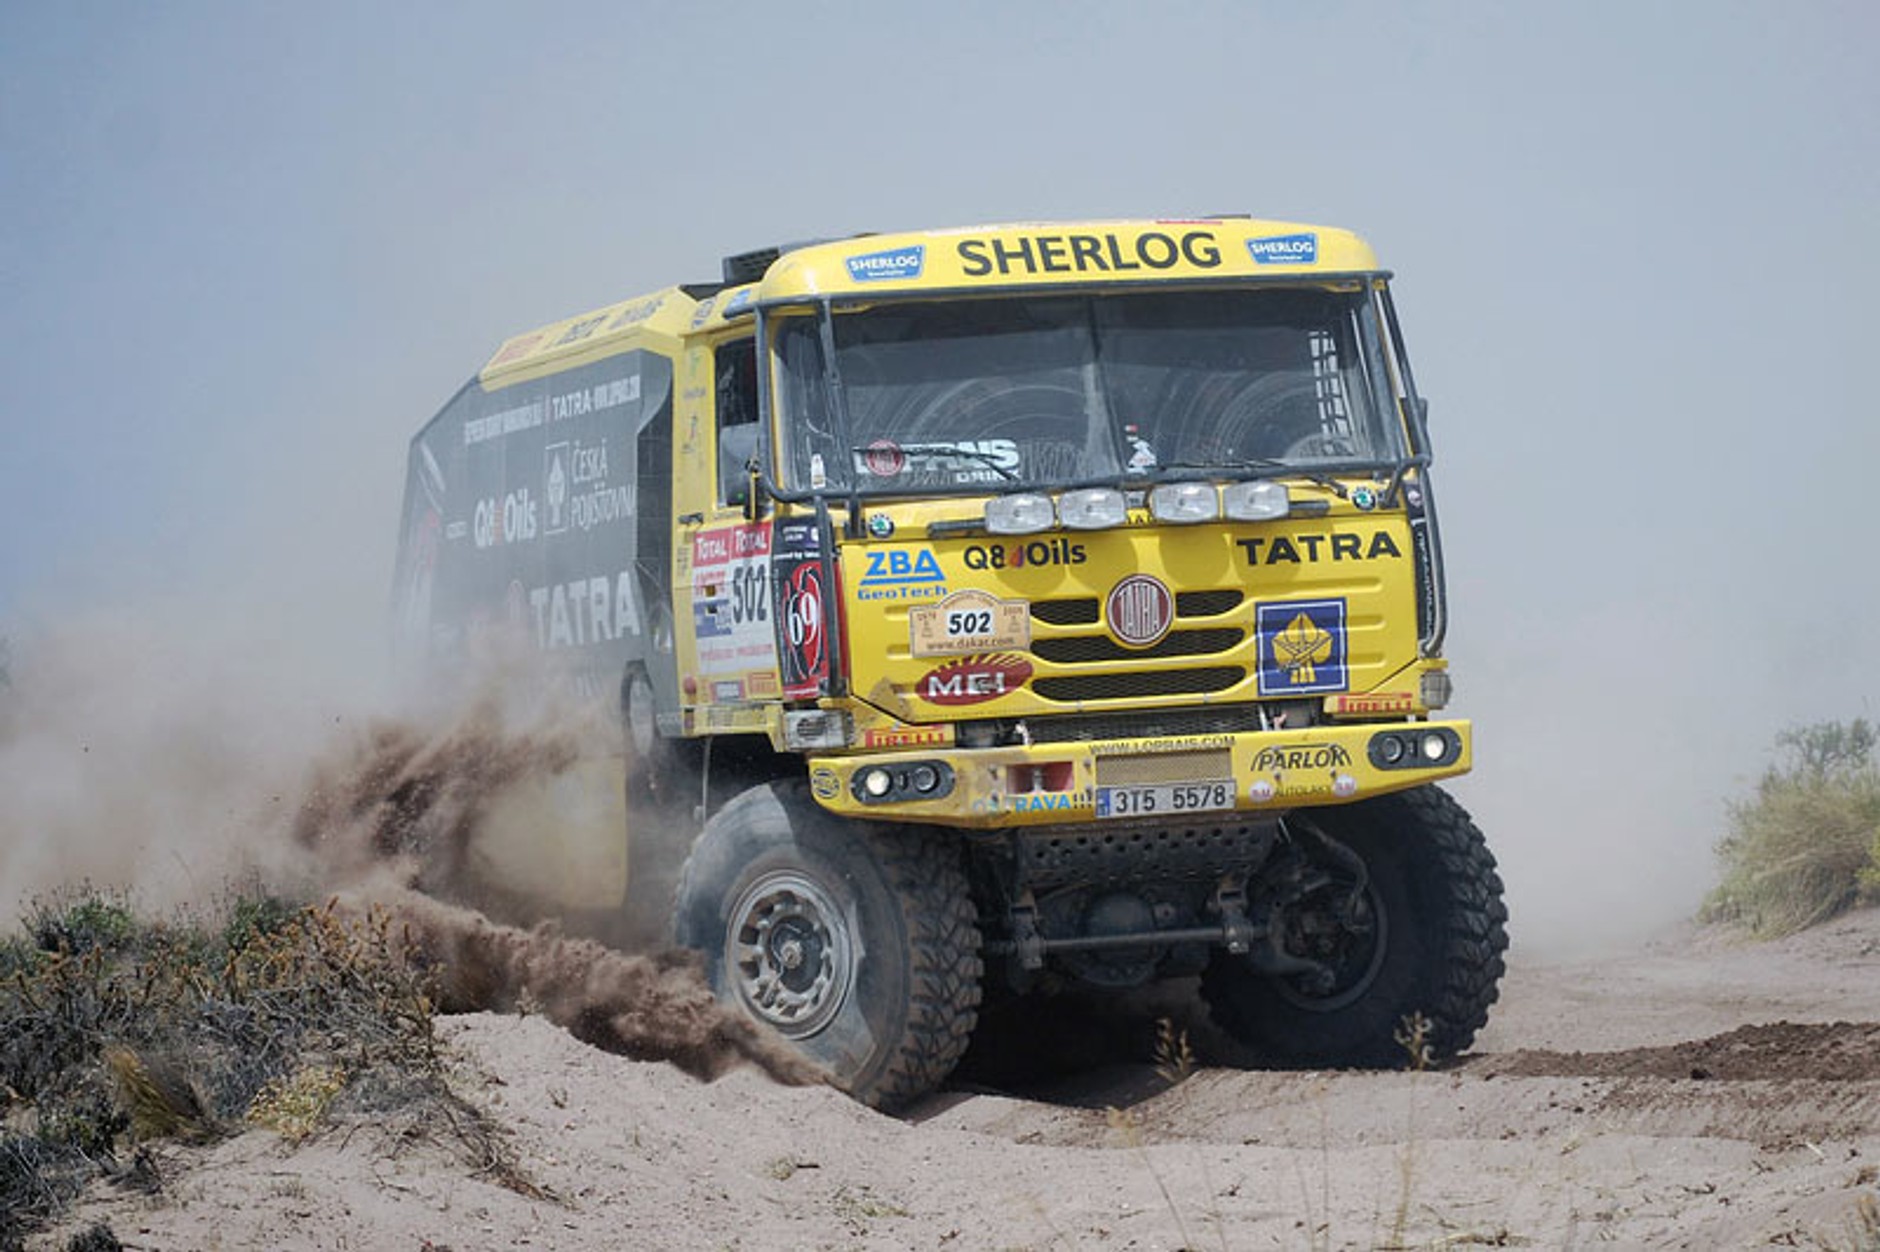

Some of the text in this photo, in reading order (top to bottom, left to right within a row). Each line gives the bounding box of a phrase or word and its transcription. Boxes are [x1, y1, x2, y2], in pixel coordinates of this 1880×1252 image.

[957, 232, 1220, 276] SHERLOG
[1250, 241, 1313, 254] SHERLOG
[850, 255, 919, 272] SHERLOG
[552, 388, 592, 420] TATRA
[504, 487, 537, 543] Oils
[696, 537, 727, 560] TOTAL
[735, 528, 768, 552] TOTAL
[963, 538, 1087, 570] Q8 Oils
[1236, 531, 1401, 566] TATRA
[864, 549, 945, 580] ZBA
[733, 564, 767, 624] 502
[857, 585, 948, 601] GeoTech
[530, 569, 641, 649] TATRA
[948, 611, 992, 635] 502
[1337, 692, 1412, 714] PIRELLI
[1257, 748, 1345, 771] PARLOK
[1115, 790, 1156, 814] 3T5
[1172, 784, 1226, 810] 5578
